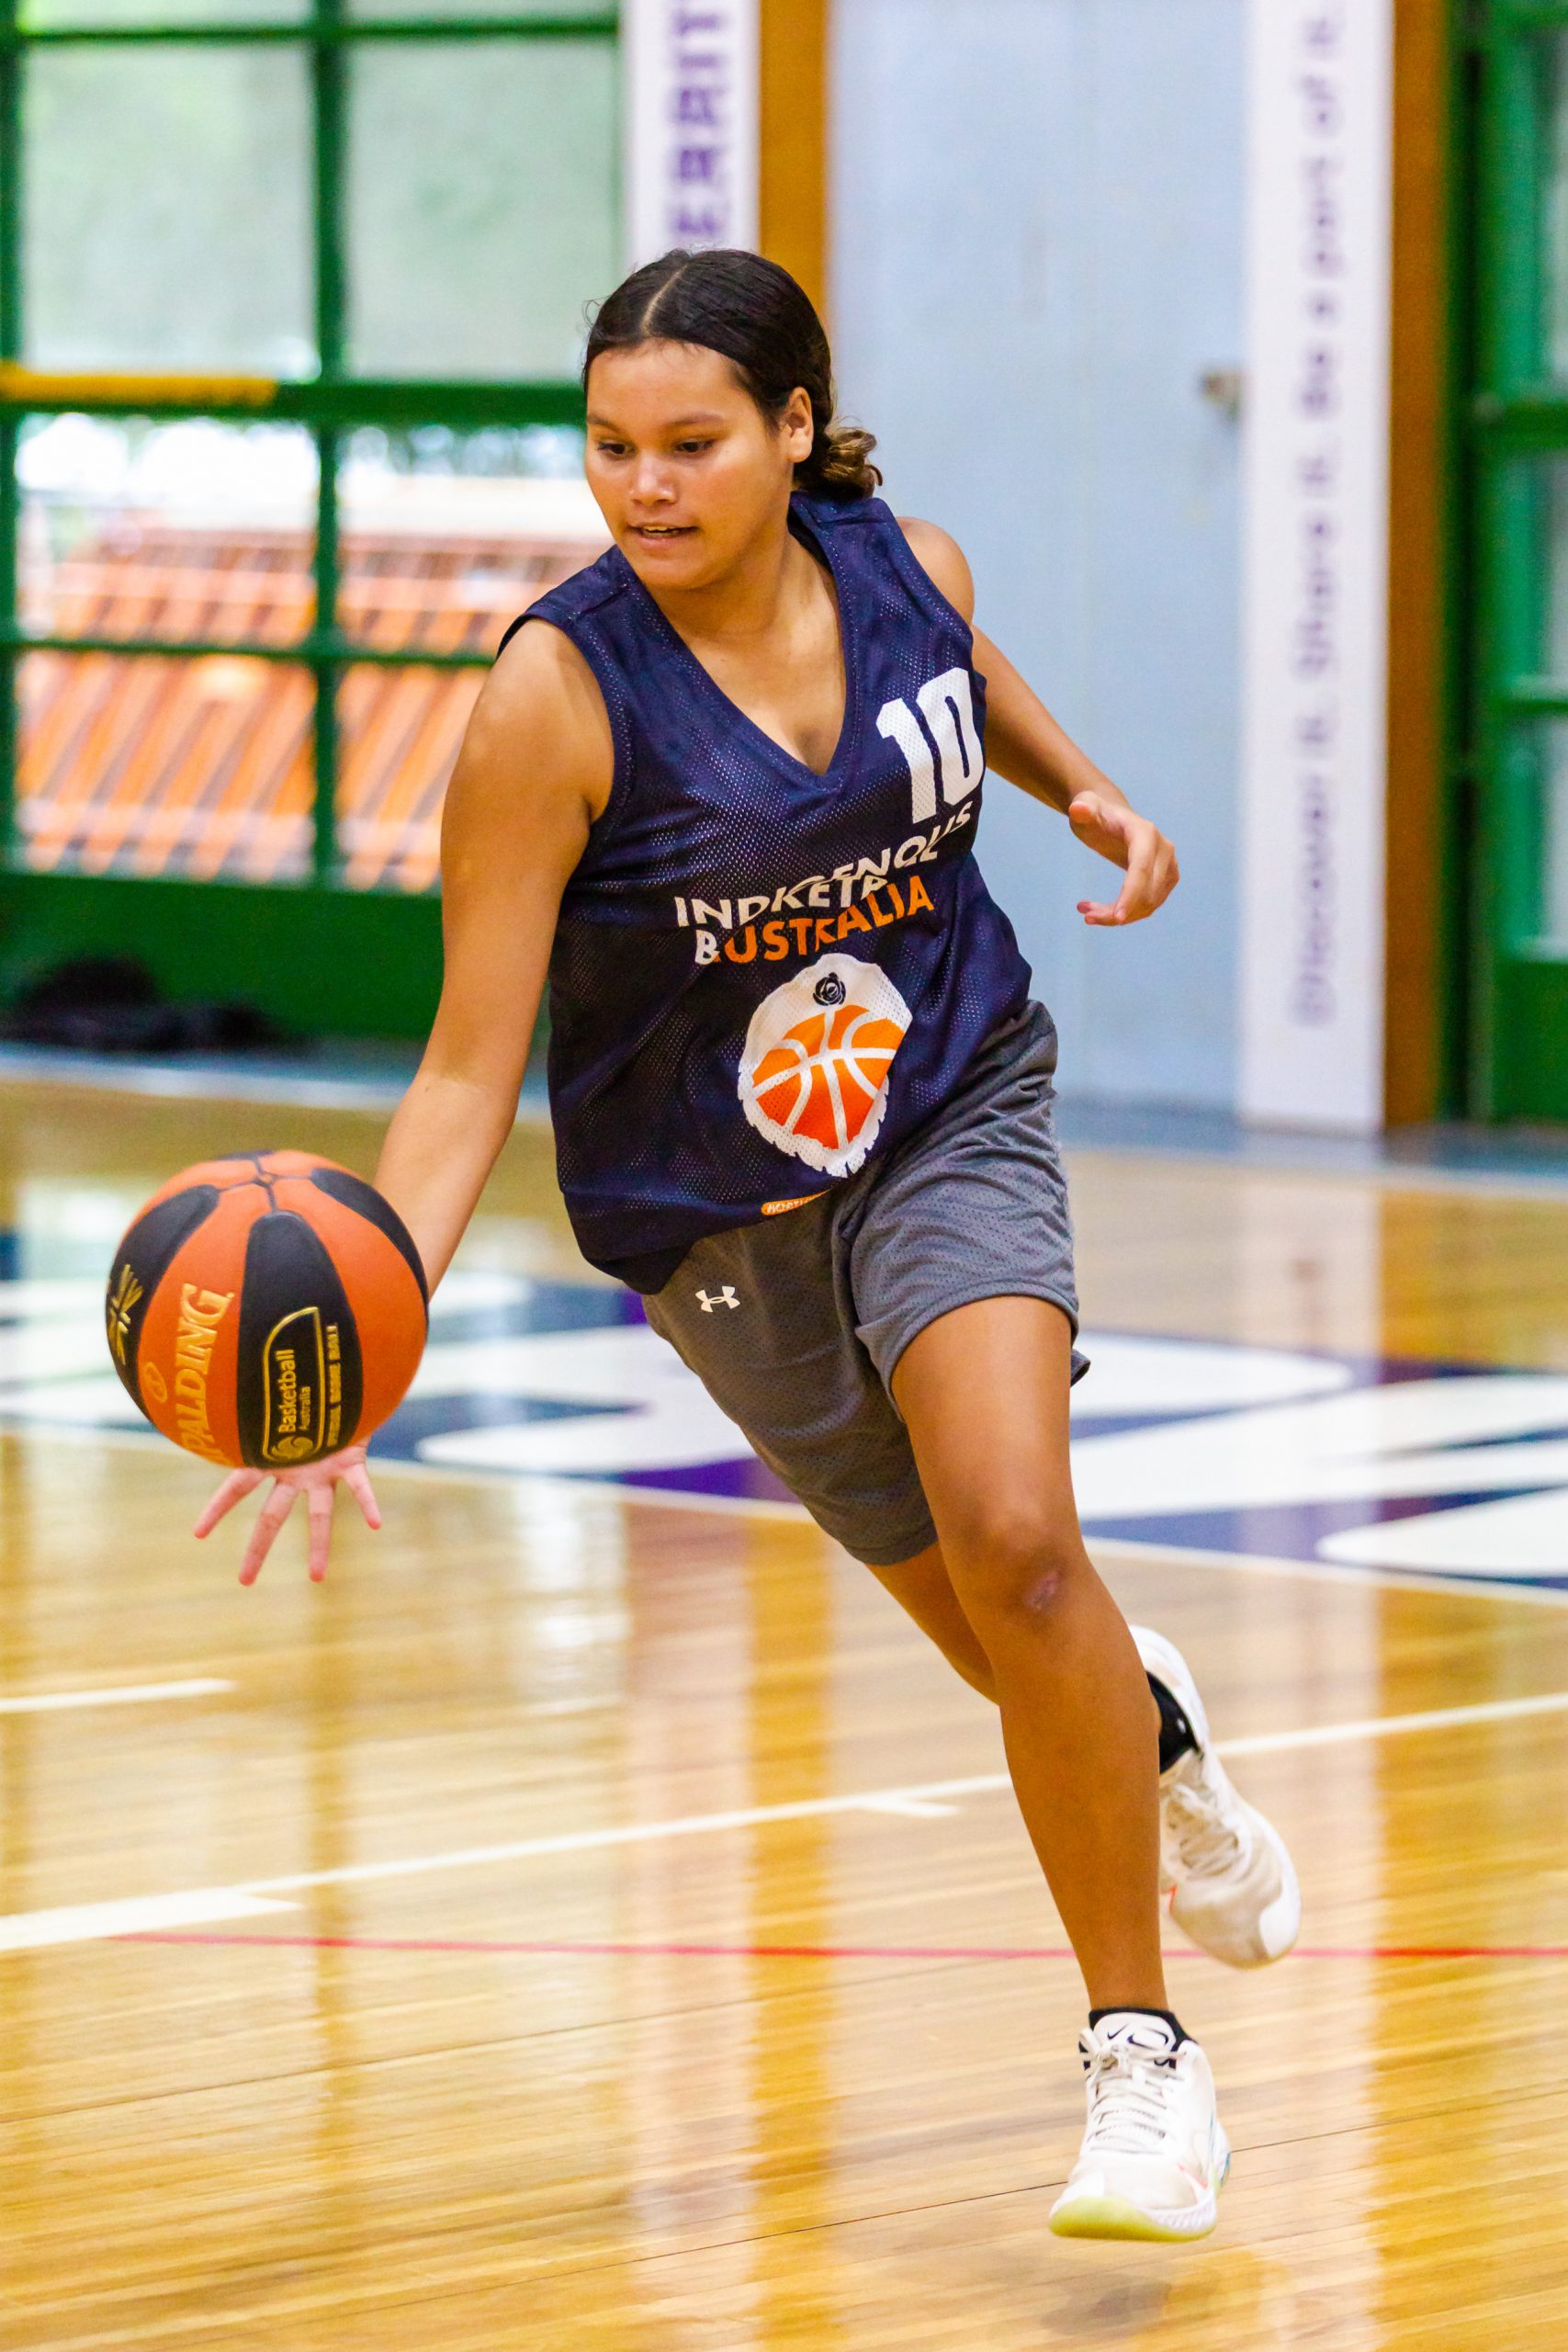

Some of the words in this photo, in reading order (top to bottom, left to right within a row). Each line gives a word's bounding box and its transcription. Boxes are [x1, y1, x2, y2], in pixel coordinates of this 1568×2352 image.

[876, 667, 985, 824] 10
[714, 876, 934, 963] USTRALIA
[275, 1349, 296, 1434] Basketball
[300, 1385, 311, 1430] Australia
